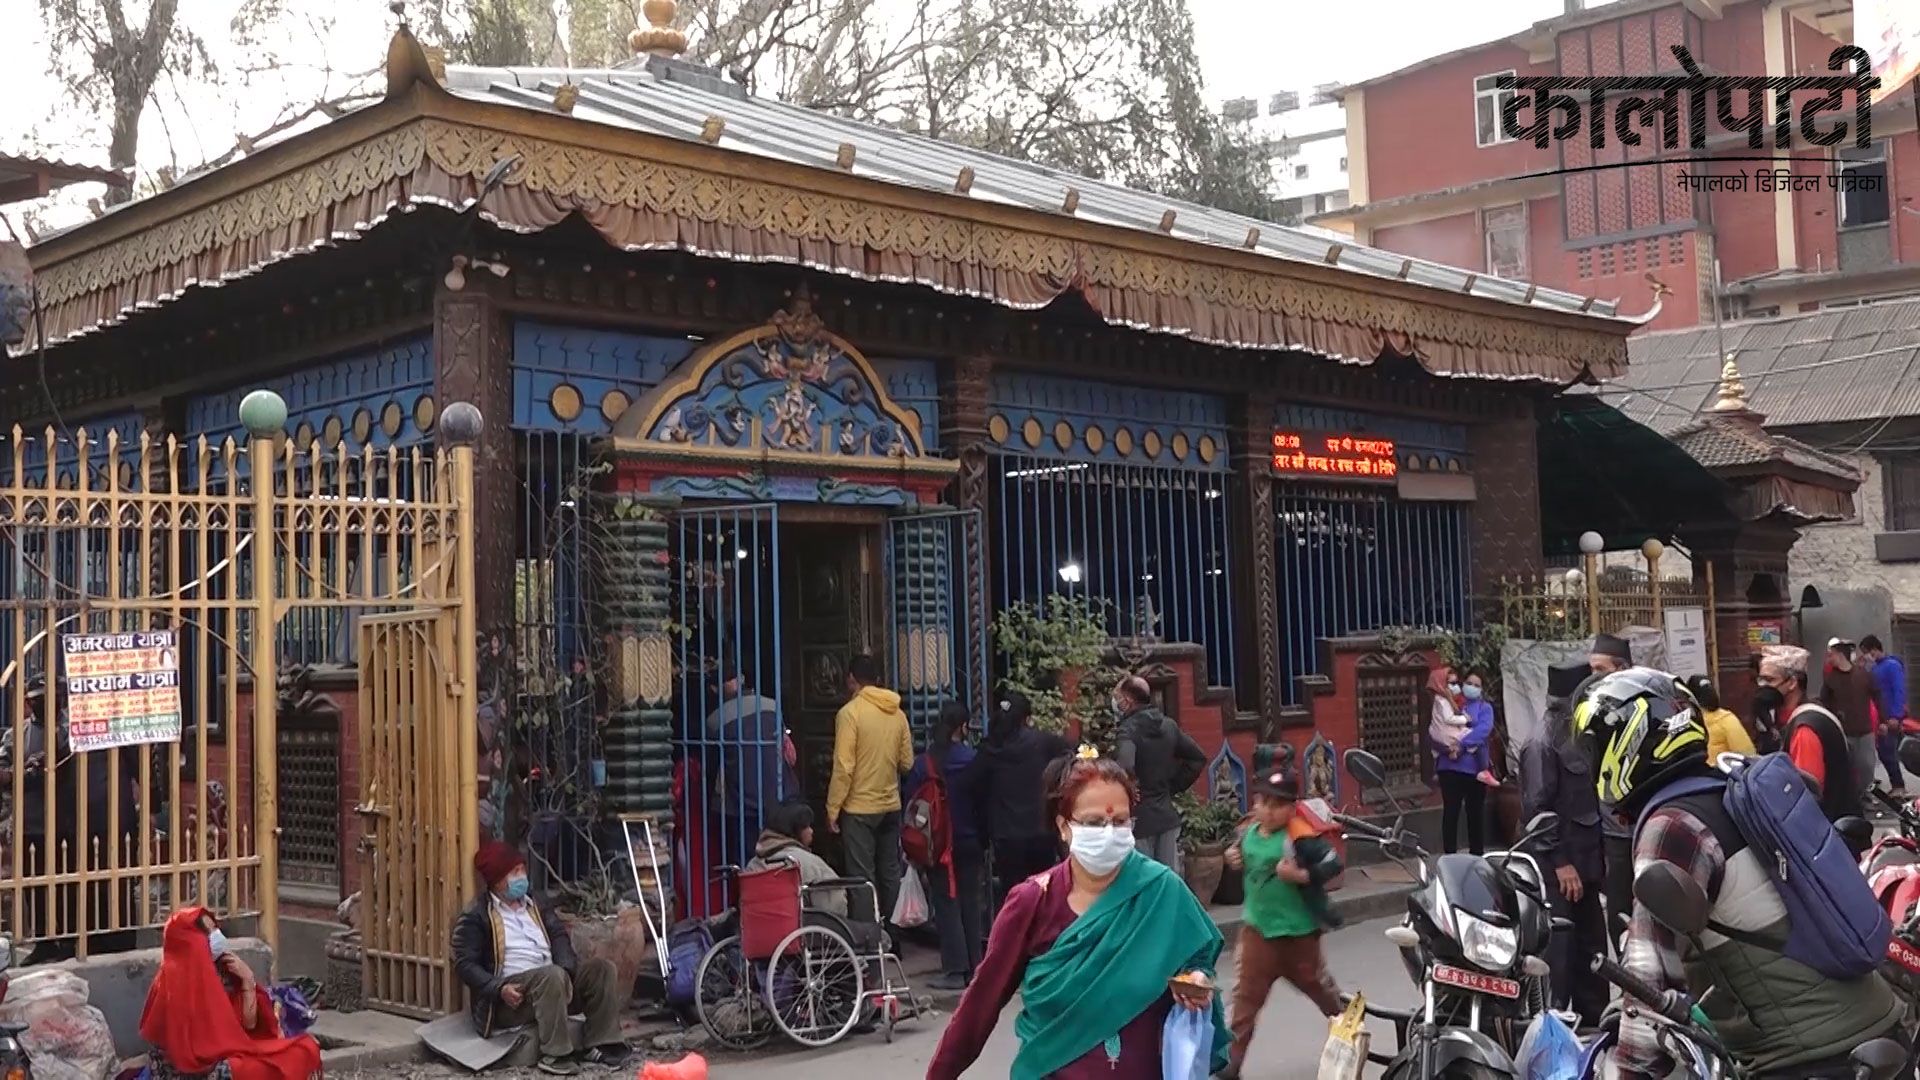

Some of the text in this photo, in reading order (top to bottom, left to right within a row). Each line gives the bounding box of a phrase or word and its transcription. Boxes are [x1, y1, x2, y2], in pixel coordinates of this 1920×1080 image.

[67, 632, 173, 653] अमरनाथ यात्रा
[136, 671, 175, 687] यात्रा
